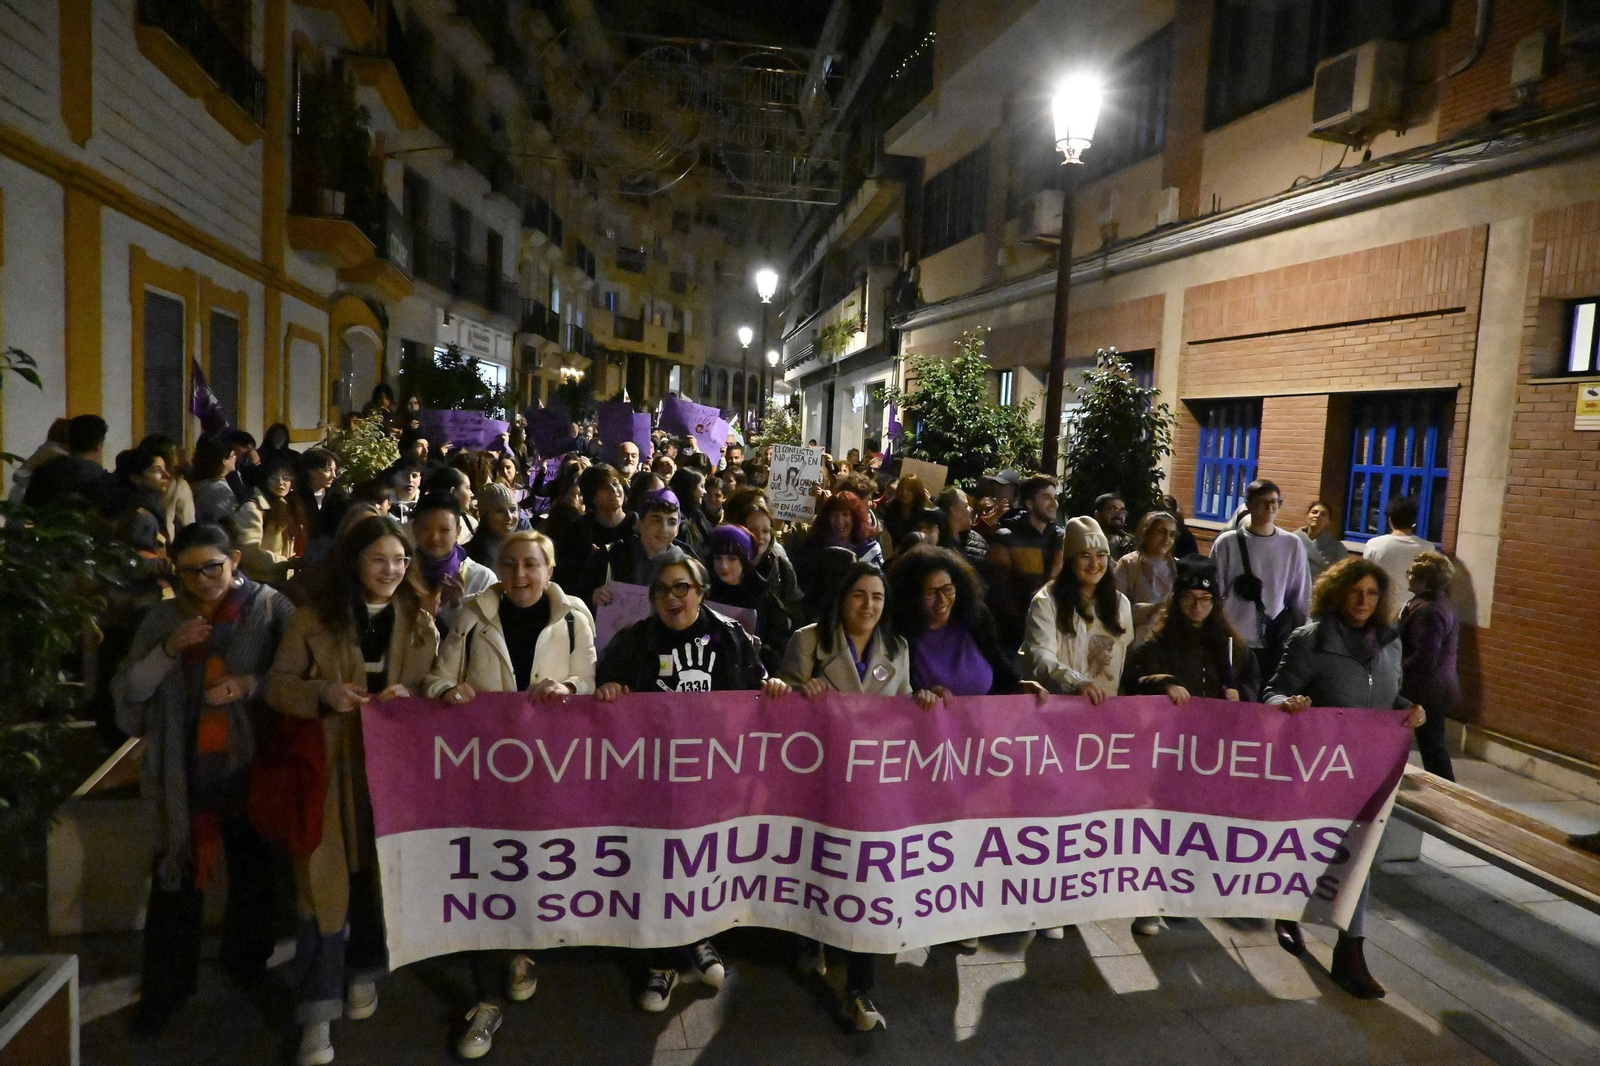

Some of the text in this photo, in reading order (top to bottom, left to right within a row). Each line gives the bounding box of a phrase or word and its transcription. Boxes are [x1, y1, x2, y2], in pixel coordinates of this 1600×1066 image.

[782, 445, 814, 456] CONFLICTO
[774, 454, 786, 462] NO
[808, 457, 818, 466] EN
[773, 473, 782, 481] LA
[770, 482, 782, 491] QUE
[780, 503, 790, 511] EN
[791, 504, 801, 513] LOS
[1084, 534, 1101, 549] M
[434, 731, 824, 784] MOVIMIENTO
[1075, 733, 1135, 772] DE
[1152, 731, 1355, 782] HUELVA
[449, 817, 1351, 884] 1335 MUJERES ASESINADAS
[443, 866, 1341, 930] NO SON NÚMEROS, SON NUESTRAS VIDAS
